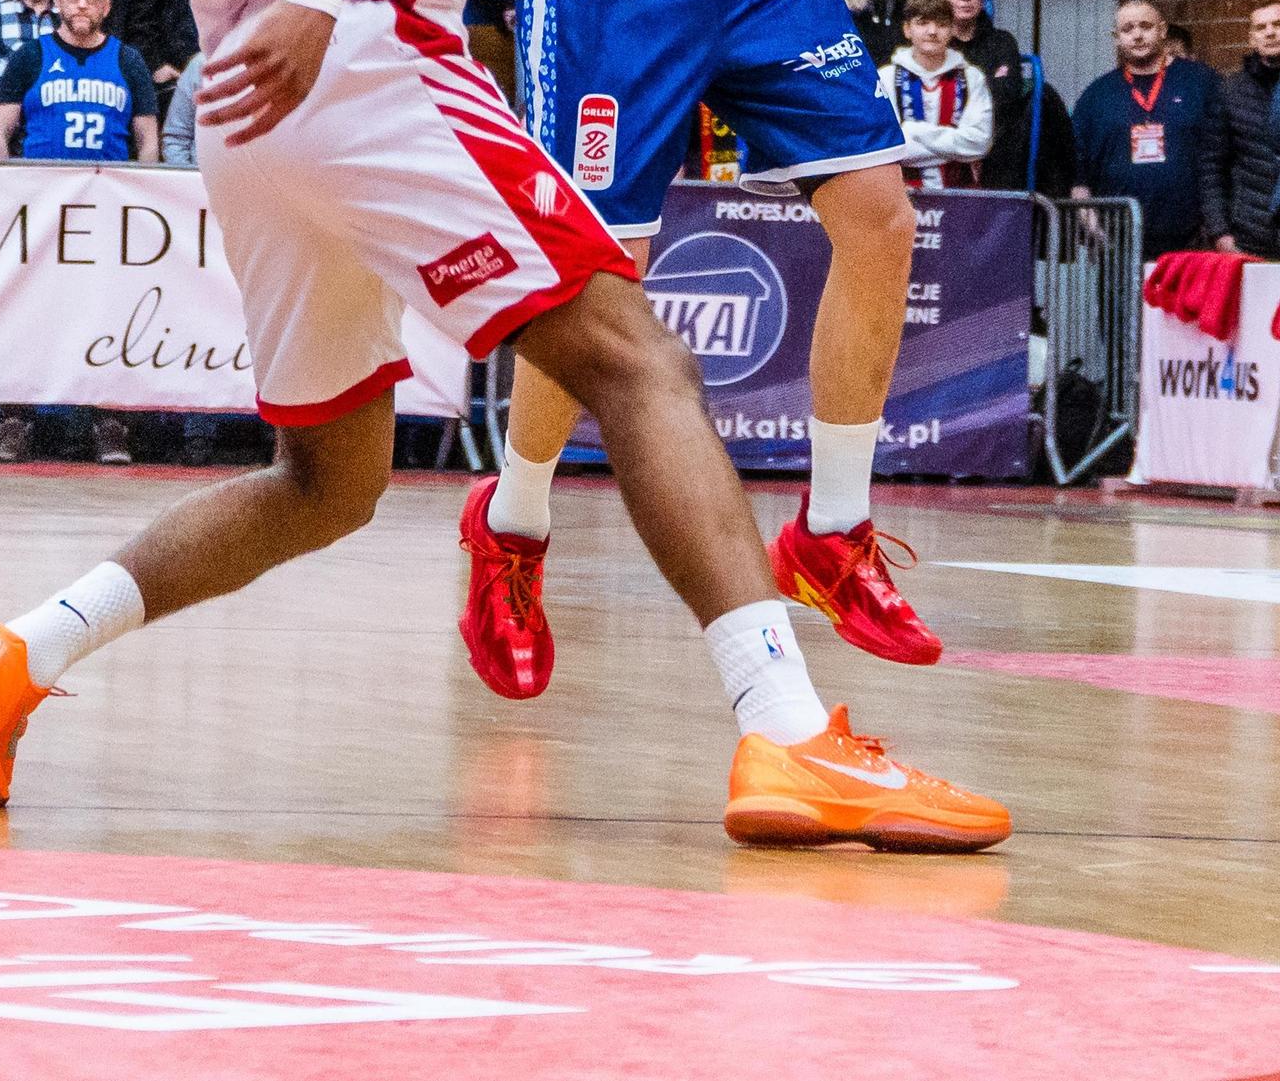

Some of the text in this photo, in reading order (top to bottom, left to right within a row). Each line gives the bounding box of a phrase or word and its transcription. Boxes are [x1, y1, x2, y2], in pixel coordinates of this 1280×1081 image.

[820, 58, 863, 80] logistics
[40, 78, 127, 113] ORLANDO
[583, 108, 614, 117] ORLEN
[64, 111, 106, 151] 22
[578, 163, 609, 173] Basket
[583, 172, 604, 183] Liga
[1158, 345, 1260, 402] work4us
